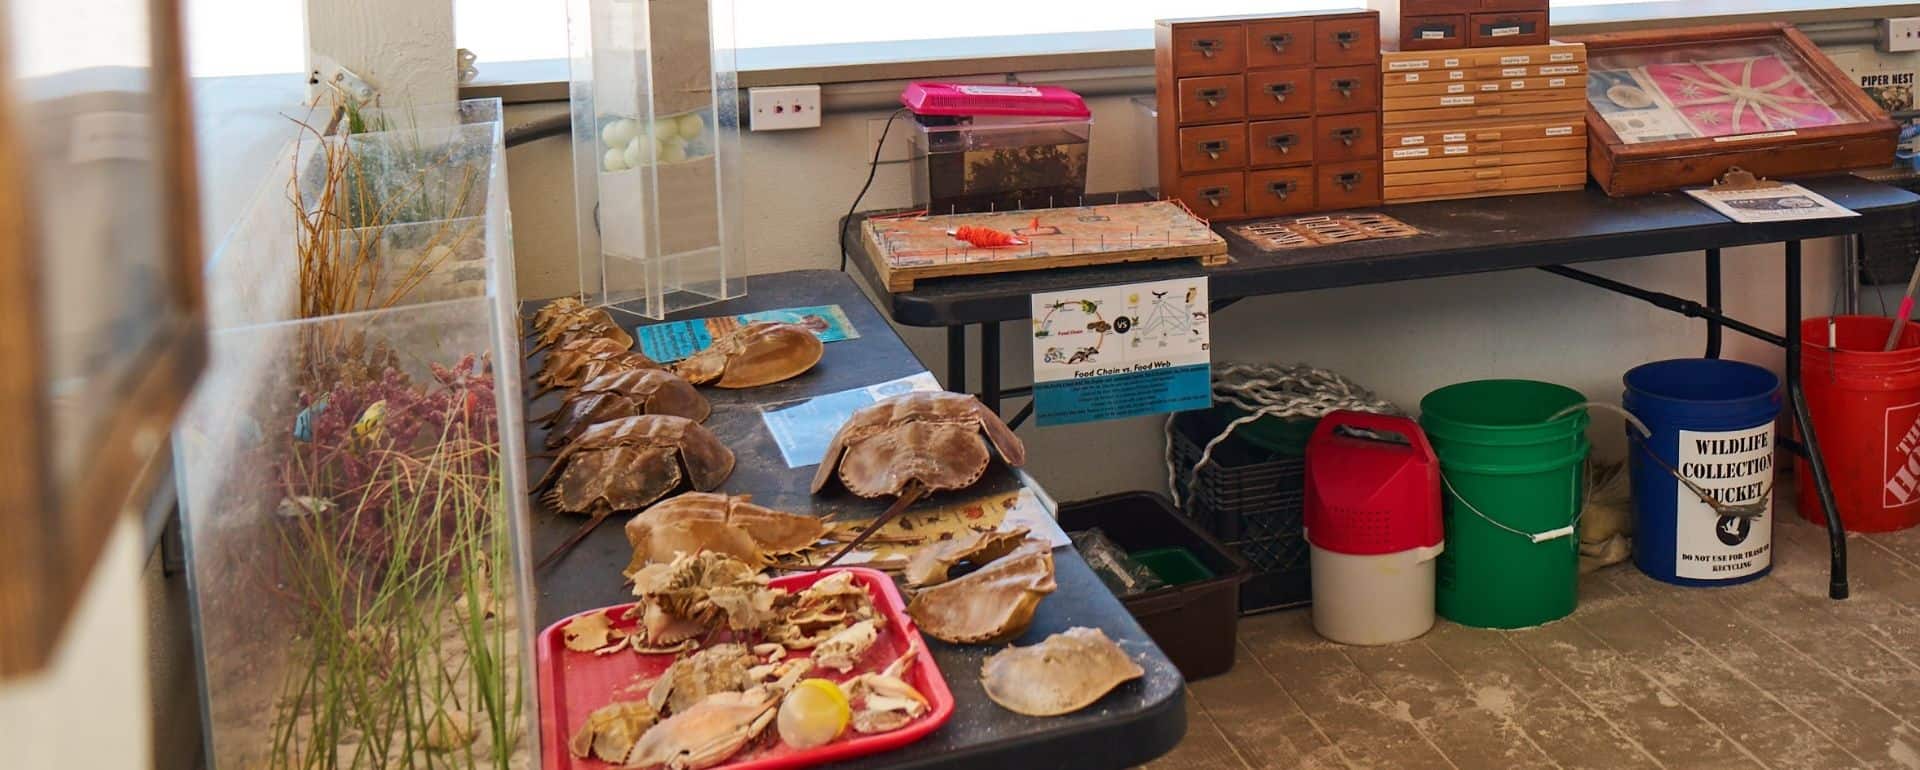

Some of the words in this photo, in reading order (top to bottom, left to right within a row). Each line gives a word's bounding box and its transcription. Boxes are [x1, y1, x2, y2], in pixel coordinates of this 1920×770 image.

[1861, 74, 1889, 86] PIPER
[1892, 73, 1914, 85] NEST
[1117, 320, 1127, 328] VS
[1074, 369, 1095, 379] Food
[1096, 366, 1120, 376] Chain
[1134, 362, 1153, 372] Food
[1154, 360, 1171, 369] Web
[1695, 431, 1768, 455] WILDLIFE
[1682, 451, 1773, 479] COLLECTION
[1682, 553, 1693, 561] DO
[1694, 554, 1710, 562] NOT
[1729, 553, 1743, 561] FOR
[1744, 546, 1763, 559] TRASH
[1712, 561, 1752, 572] RECYCLING
